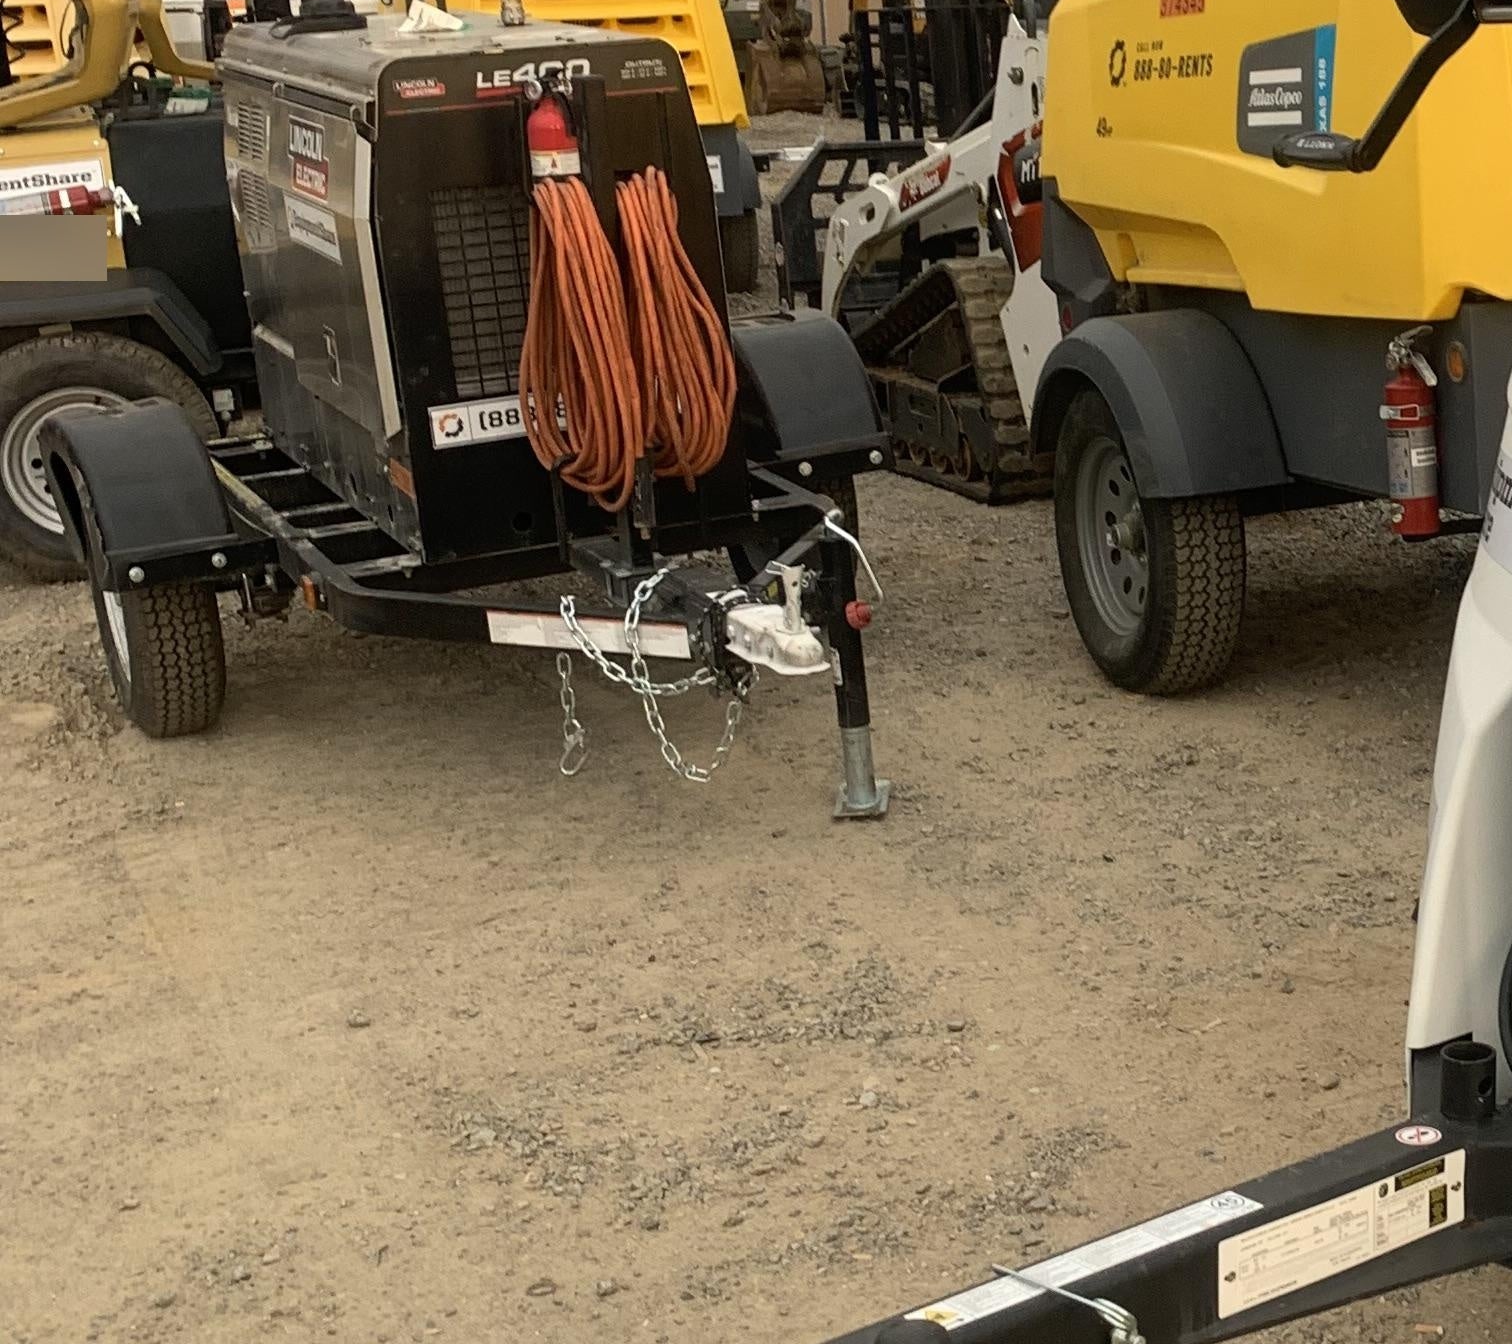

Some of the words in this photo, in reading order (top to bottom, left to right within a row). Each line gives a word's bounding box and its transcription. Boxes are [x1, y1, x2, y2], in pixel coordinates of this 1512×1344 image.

[1133, 53, 1213, 82] 888-80-RENTS
[394, 78, 438, 91] LINCOLN
[289, 122, 322, 162] LINCOLN
[296, 163, 326, 196] ELECTRIC
